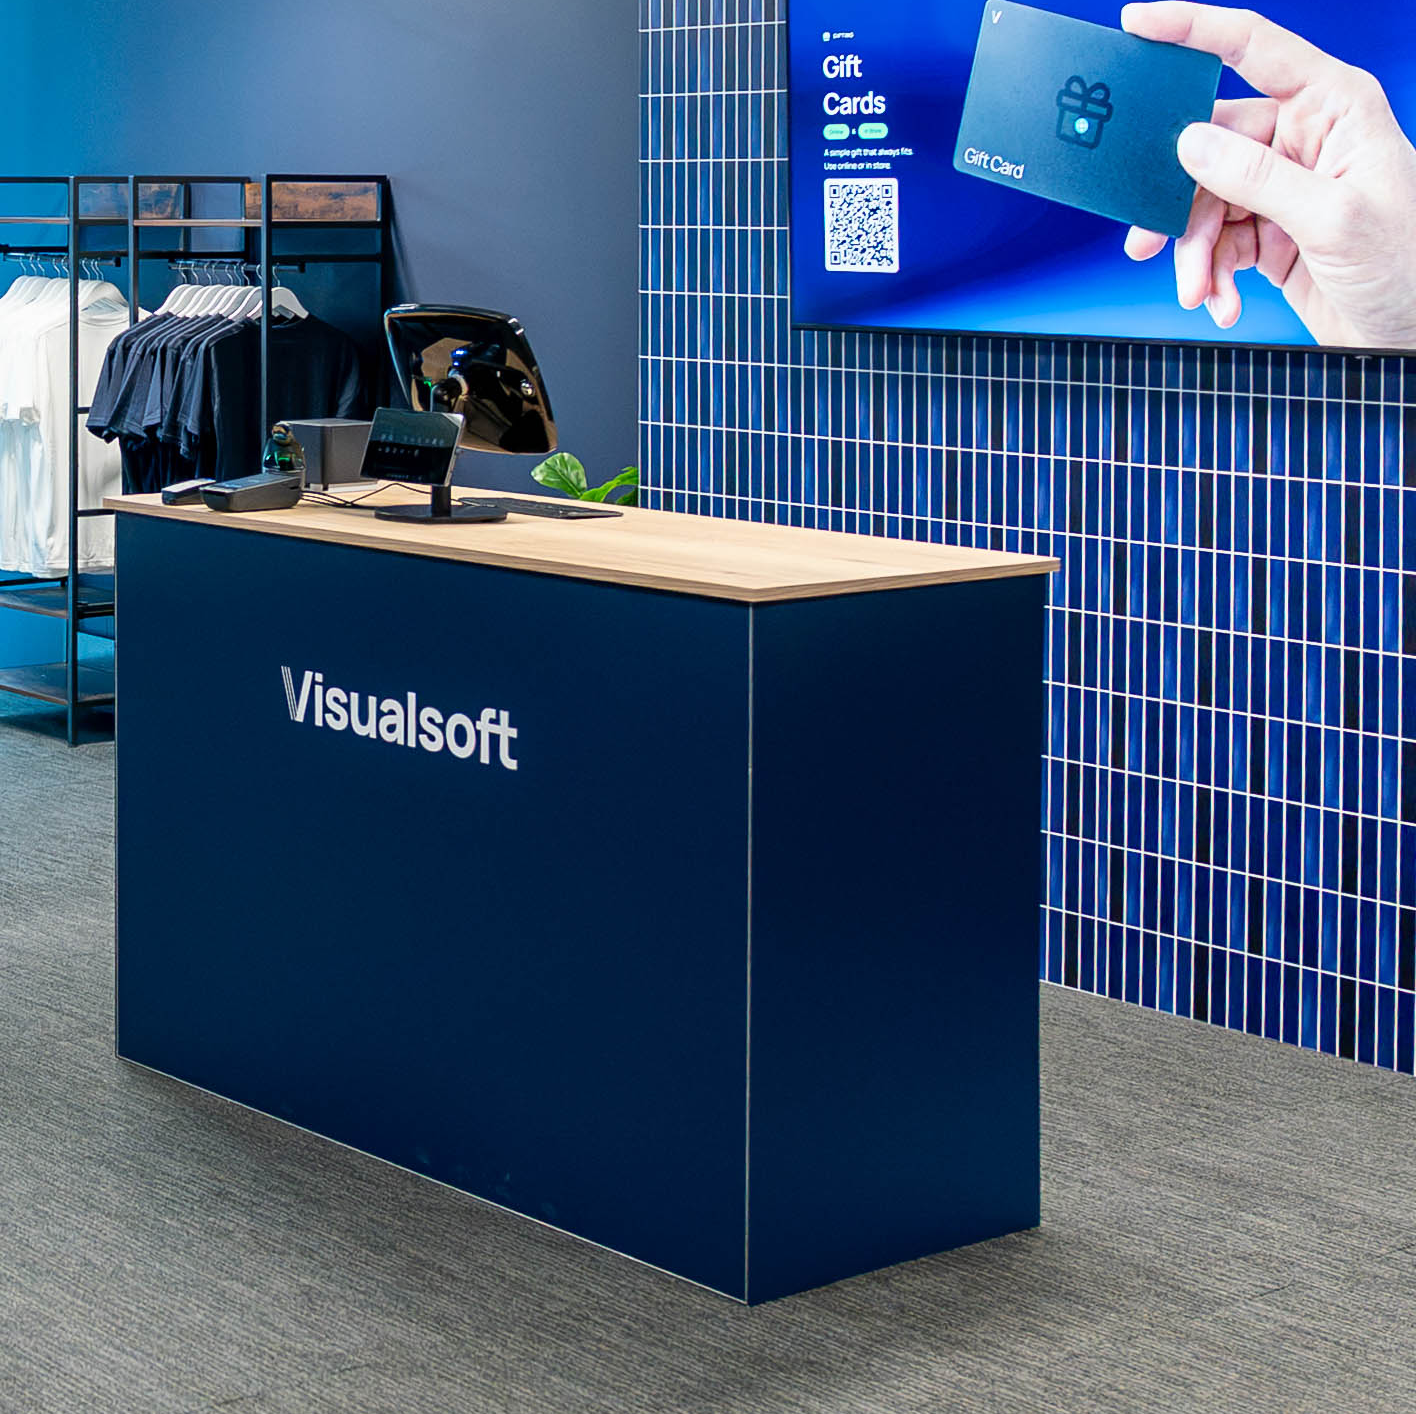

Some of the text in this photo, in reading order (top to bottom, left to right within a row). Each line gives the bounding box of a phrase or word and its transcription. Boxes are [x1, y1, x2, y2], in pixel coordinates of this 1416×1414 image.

[822, 53, 863, 78] Gift
[822, 90, 886, 116] Cards
[830, 149, 850, 158] simple
[851, 148, 862, 158] gift
[863, 148, 877, 156] that
[877, 148, 900, 157] always
[964, 147, 1025, 179] Gift Card
[824, 162, 837, 170] Use
[837, 162, 857, 170] online
[857, 162, 865, 170] or
[281, 665, 518, 771] Visualsoft
